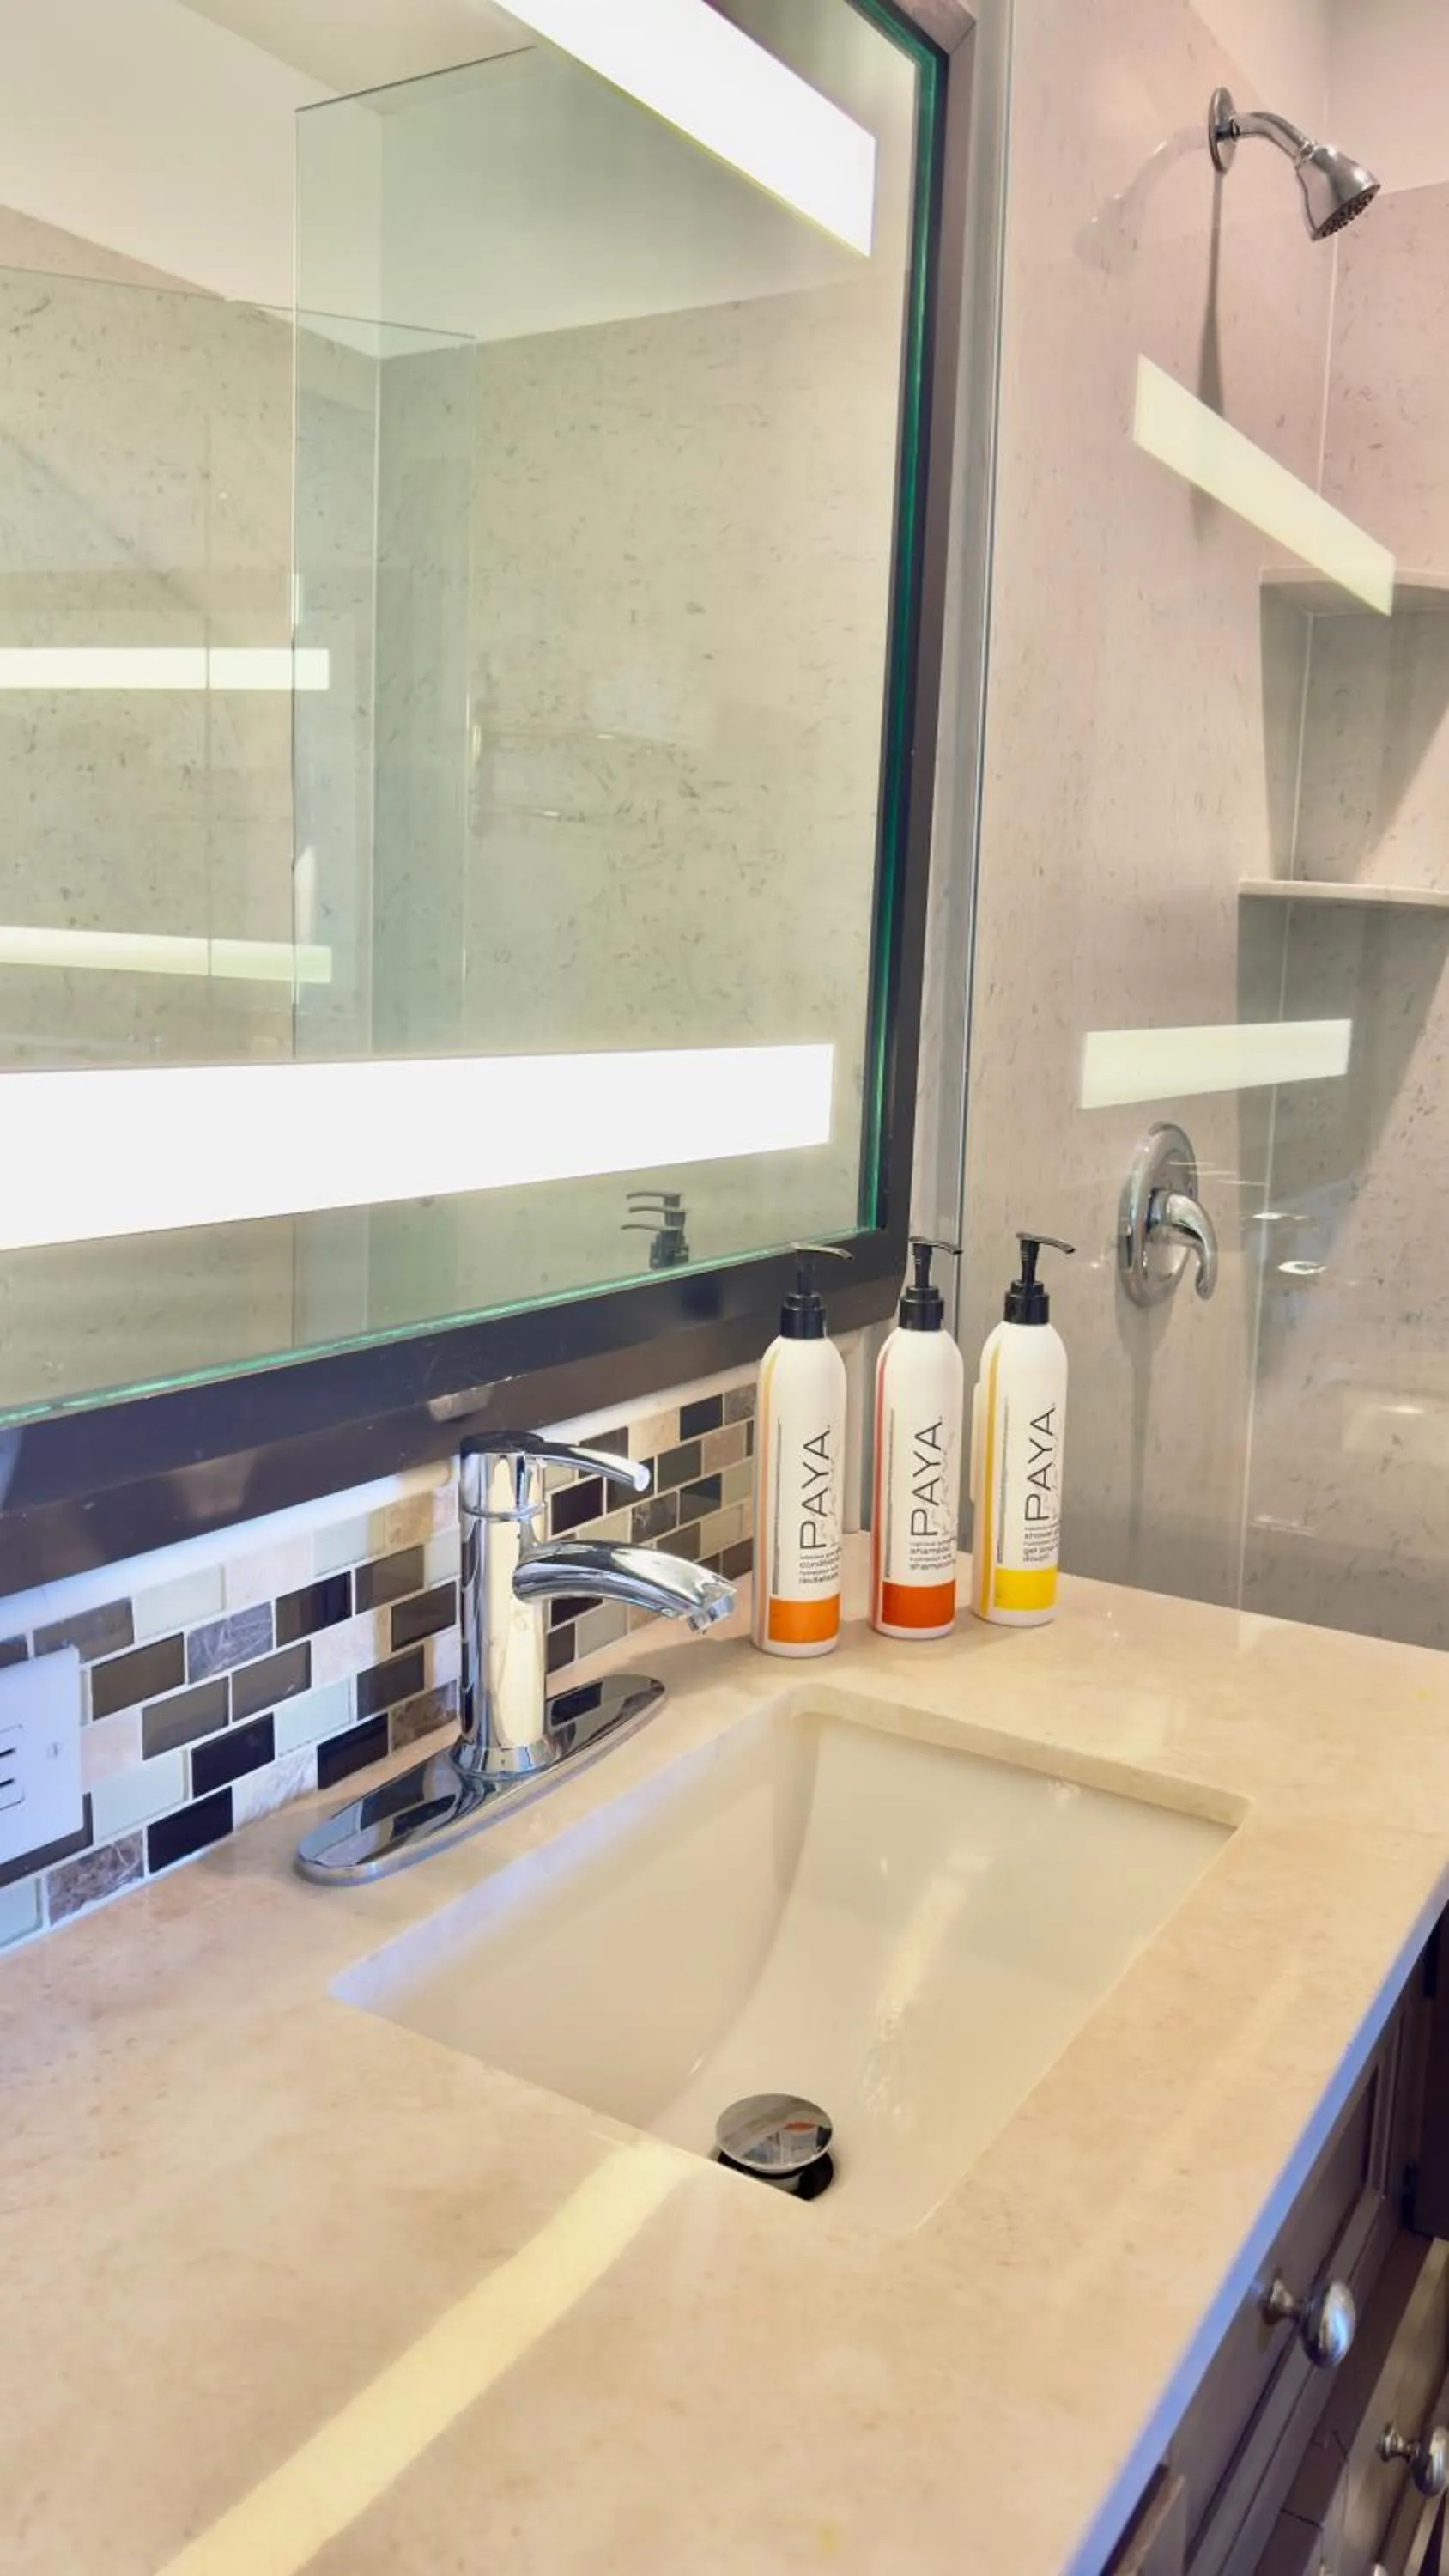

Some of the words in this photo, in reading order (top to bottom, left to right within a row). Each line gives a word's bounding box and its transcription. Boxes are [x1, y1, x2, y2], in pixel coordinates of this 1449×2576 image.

[799, 1430, 831, 1549] PAYA
[910, 1421, 943, 1536] PAYA
[1025, 1406, 1056, 1521] PAYA
